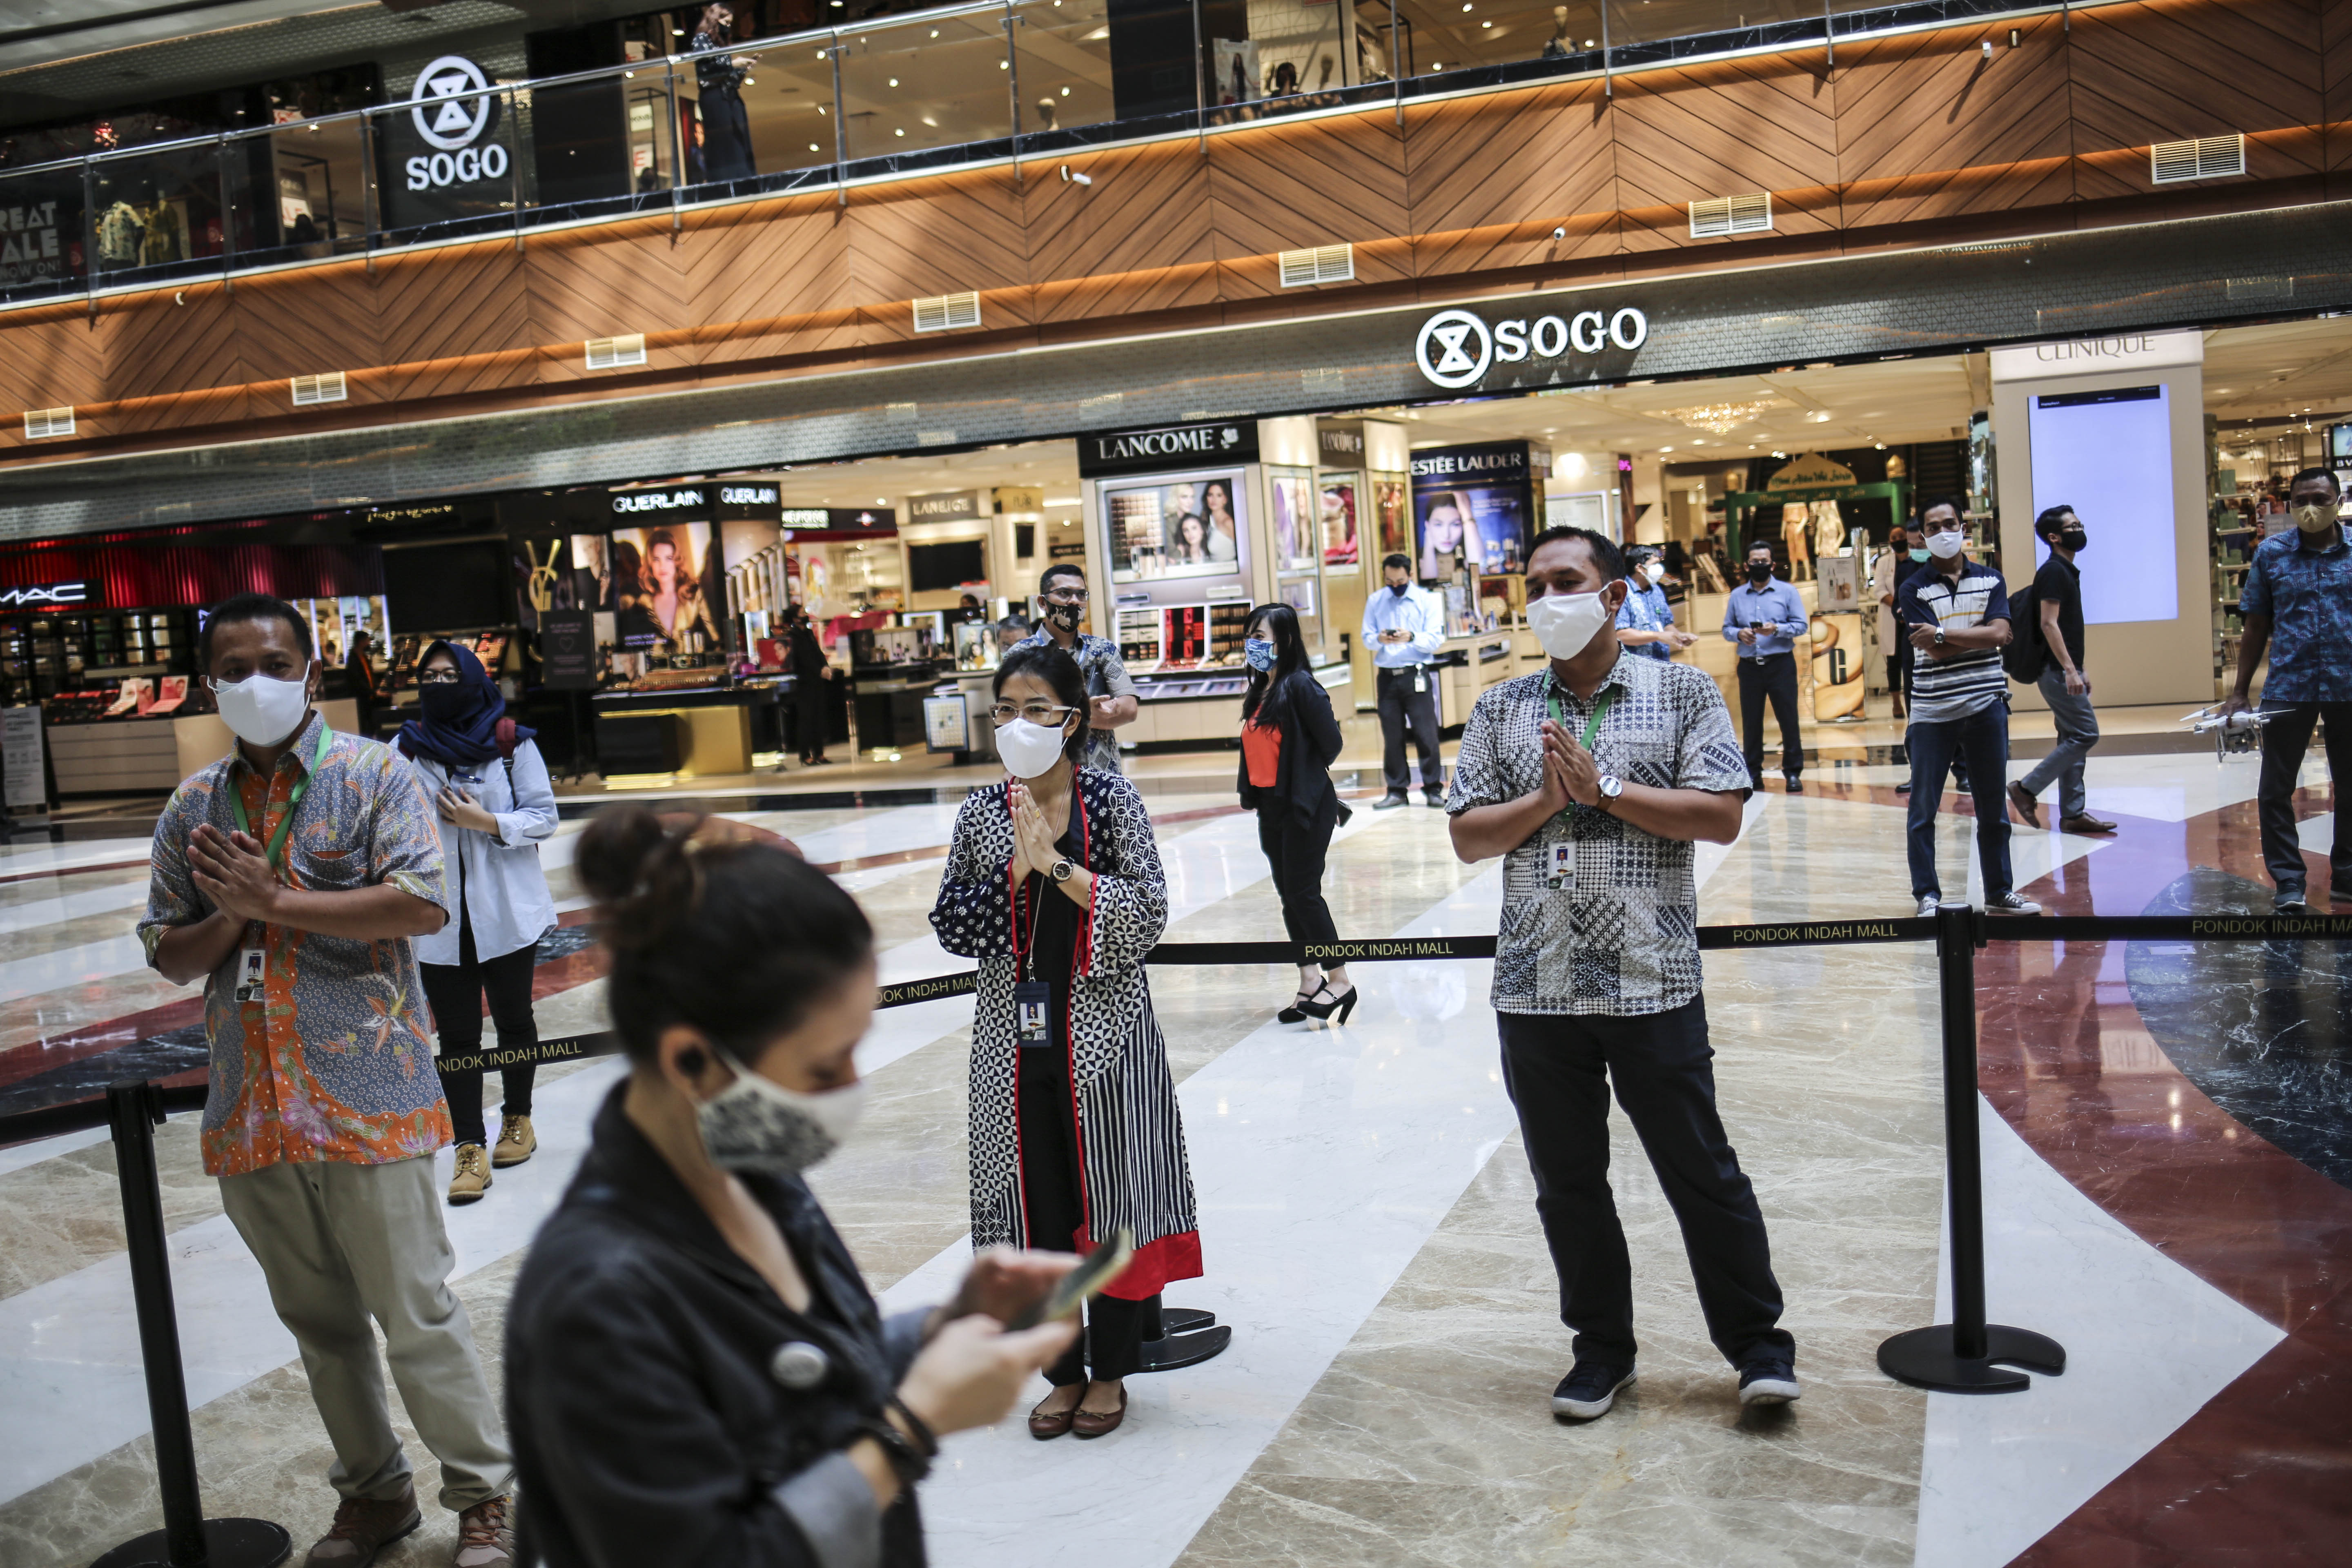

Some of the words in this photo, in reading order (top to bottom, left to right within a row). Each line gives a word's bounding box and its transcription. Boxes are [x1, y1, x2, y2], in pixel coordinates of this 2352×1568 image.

[405, 144, 508, 190] SOGO
[1494, 307, 1647, 362] SOGO
[2036, 334, 2155, 361] CLINIQUE
[1458, 452, 1521, 472] LAUDER
[613, 490, 704, 513] GUERLAIN
[721, 487, 777, 504] GUERLAIN
[913, 498, 971, 516] LANEIGE
[1733, 927, 1800, 942] PONDOK
[1805, 925, 1852, 939] INDAH
[1858, 924, 1898, 938] MALL
[2192, 920, 2267, 933] PONDOK
[2272, 919, 2325, 933] INDAH
[1305, 944, 1365, 957] PONDOK
[1370, 943, 1412, 956] INDAH
[1417, 942, 1454, 954] MALL
[907, 980, 949, 998] INDAH
[434, 1055, 485, 1073] NDOK
[490, 1047, 538, 1065] INDAH
[542, 1041, 583, 1058] MALL
